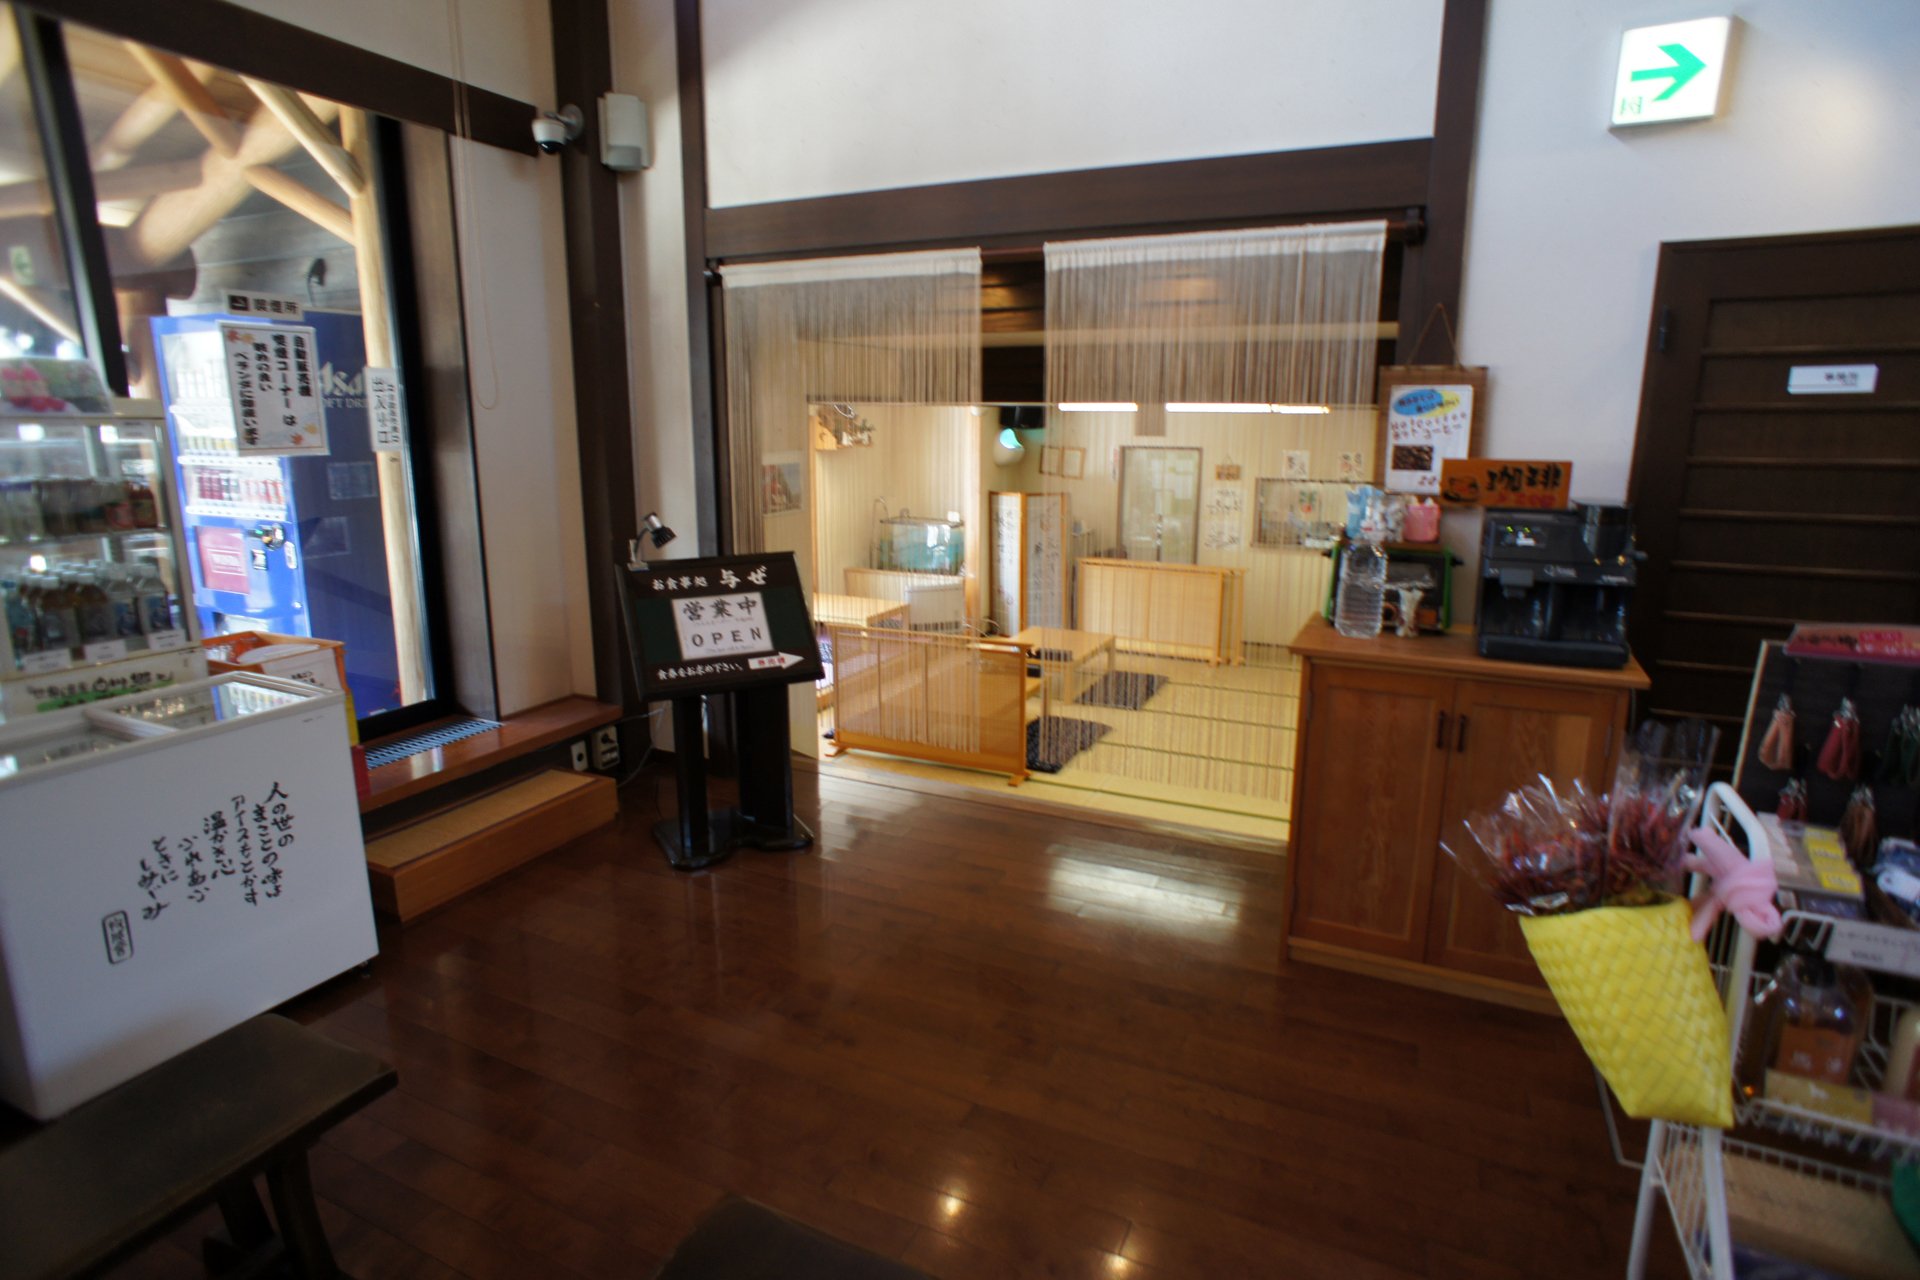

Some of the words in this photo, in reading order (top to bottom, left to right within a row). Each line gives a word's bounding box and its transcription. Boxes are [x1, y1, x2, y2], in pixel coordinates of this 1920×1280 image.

[1486, 462, 1562, 492] 珈琲
[652, 575, 708, 591] お食事処
[682, 595, 757, 622] 営業中
[692, 627, 762, 647] OPEN
[263, 781, 295, 848] 人の世の
